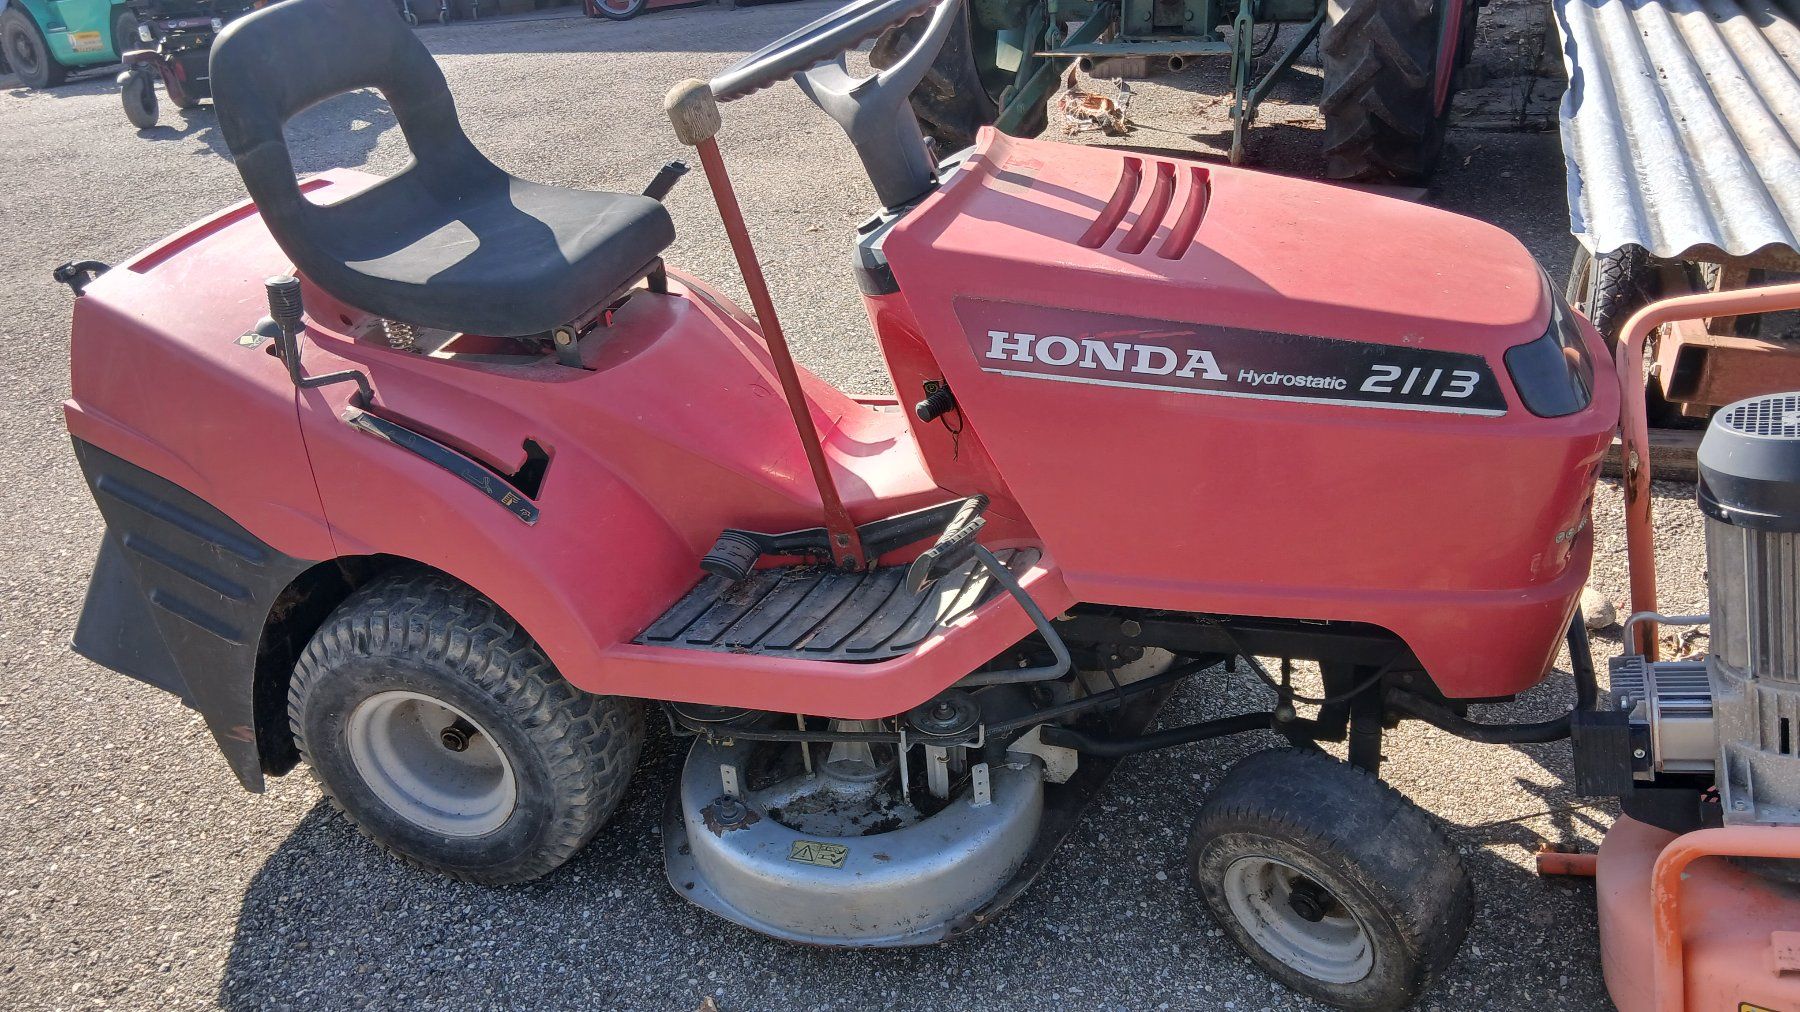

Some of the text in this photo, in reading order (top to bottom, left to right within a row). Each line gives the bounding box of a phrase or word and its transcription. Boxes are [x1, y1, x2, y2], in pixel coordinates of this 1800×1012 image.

[985, 330, 1480, 399] HONDA Hydrostatic 2113
